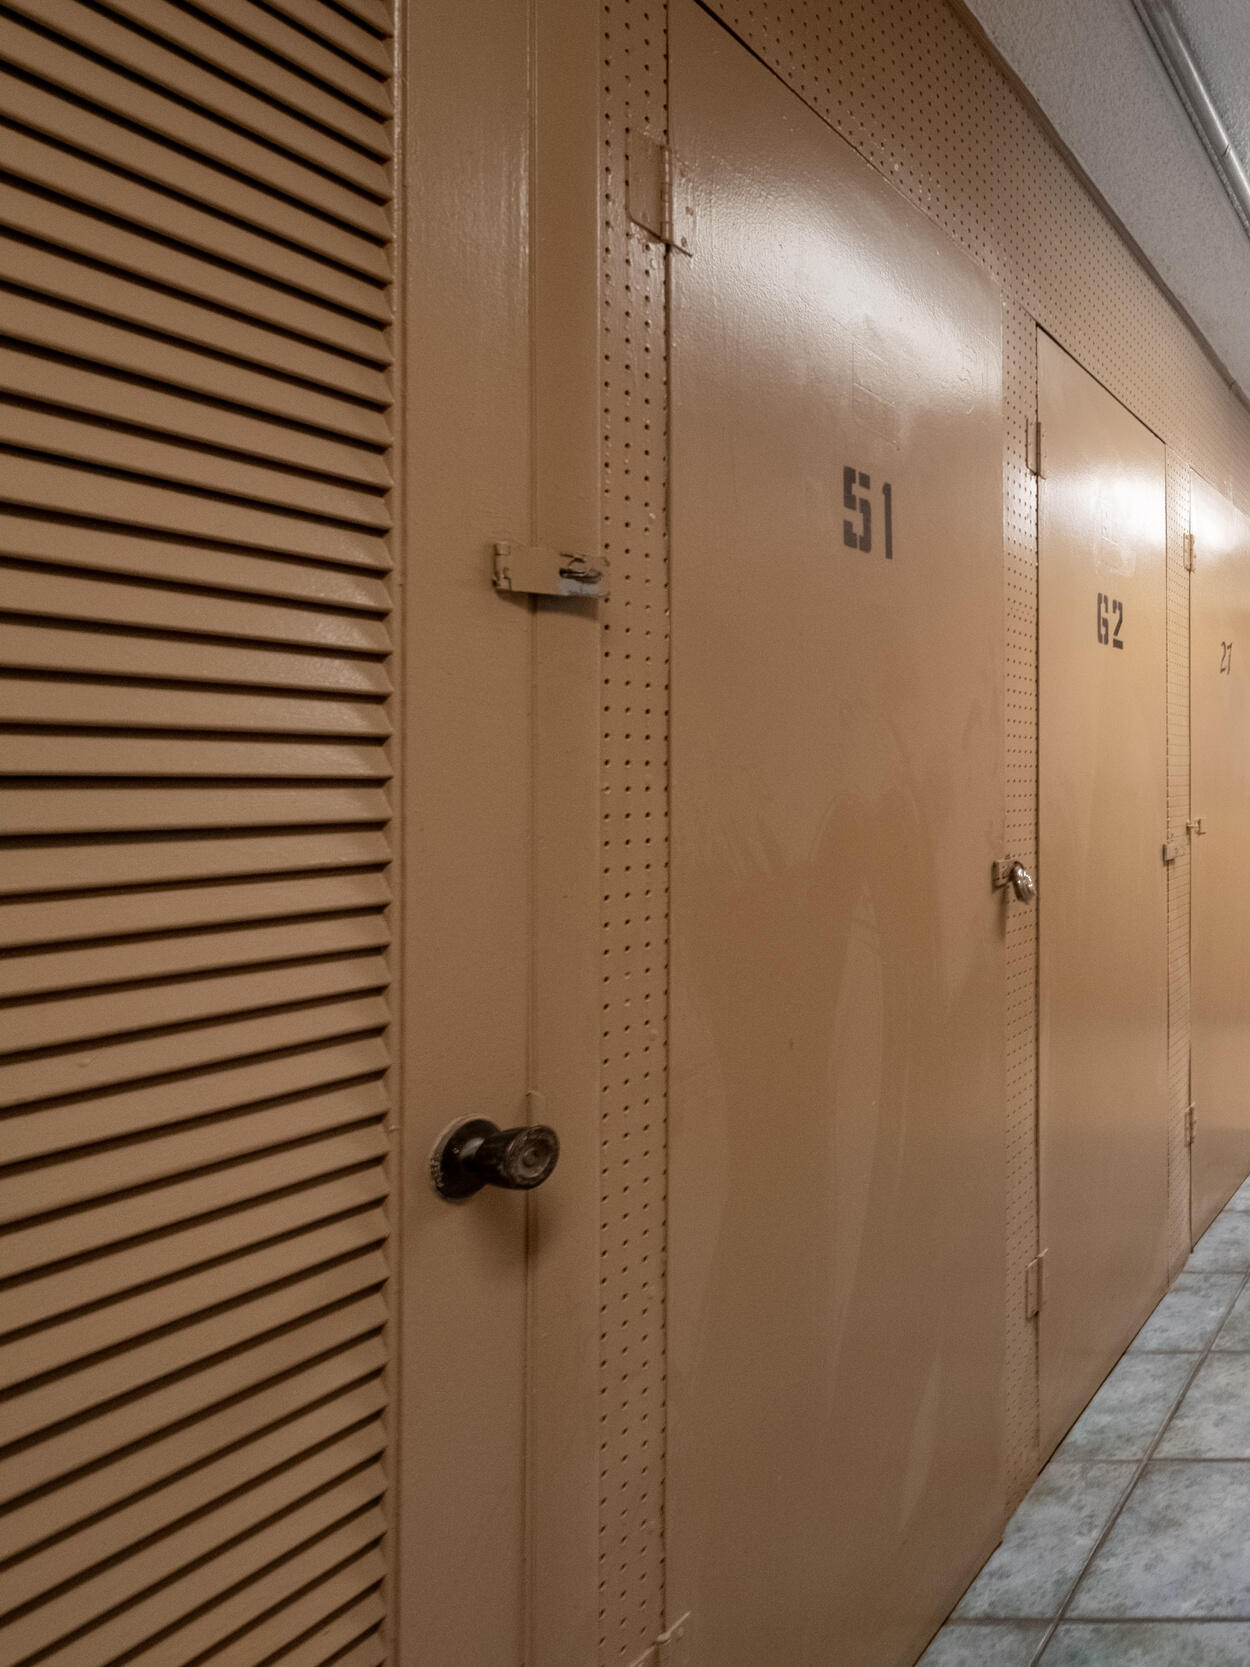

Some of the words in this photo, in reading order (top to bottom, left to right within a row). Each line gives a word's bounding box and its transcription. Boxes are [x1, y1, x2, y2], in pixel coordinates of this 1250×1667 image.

[843, 465, 893, 560] 51
[1097, 592, 1123, 650] 62
[1220, 641, 1233, 675] 27
